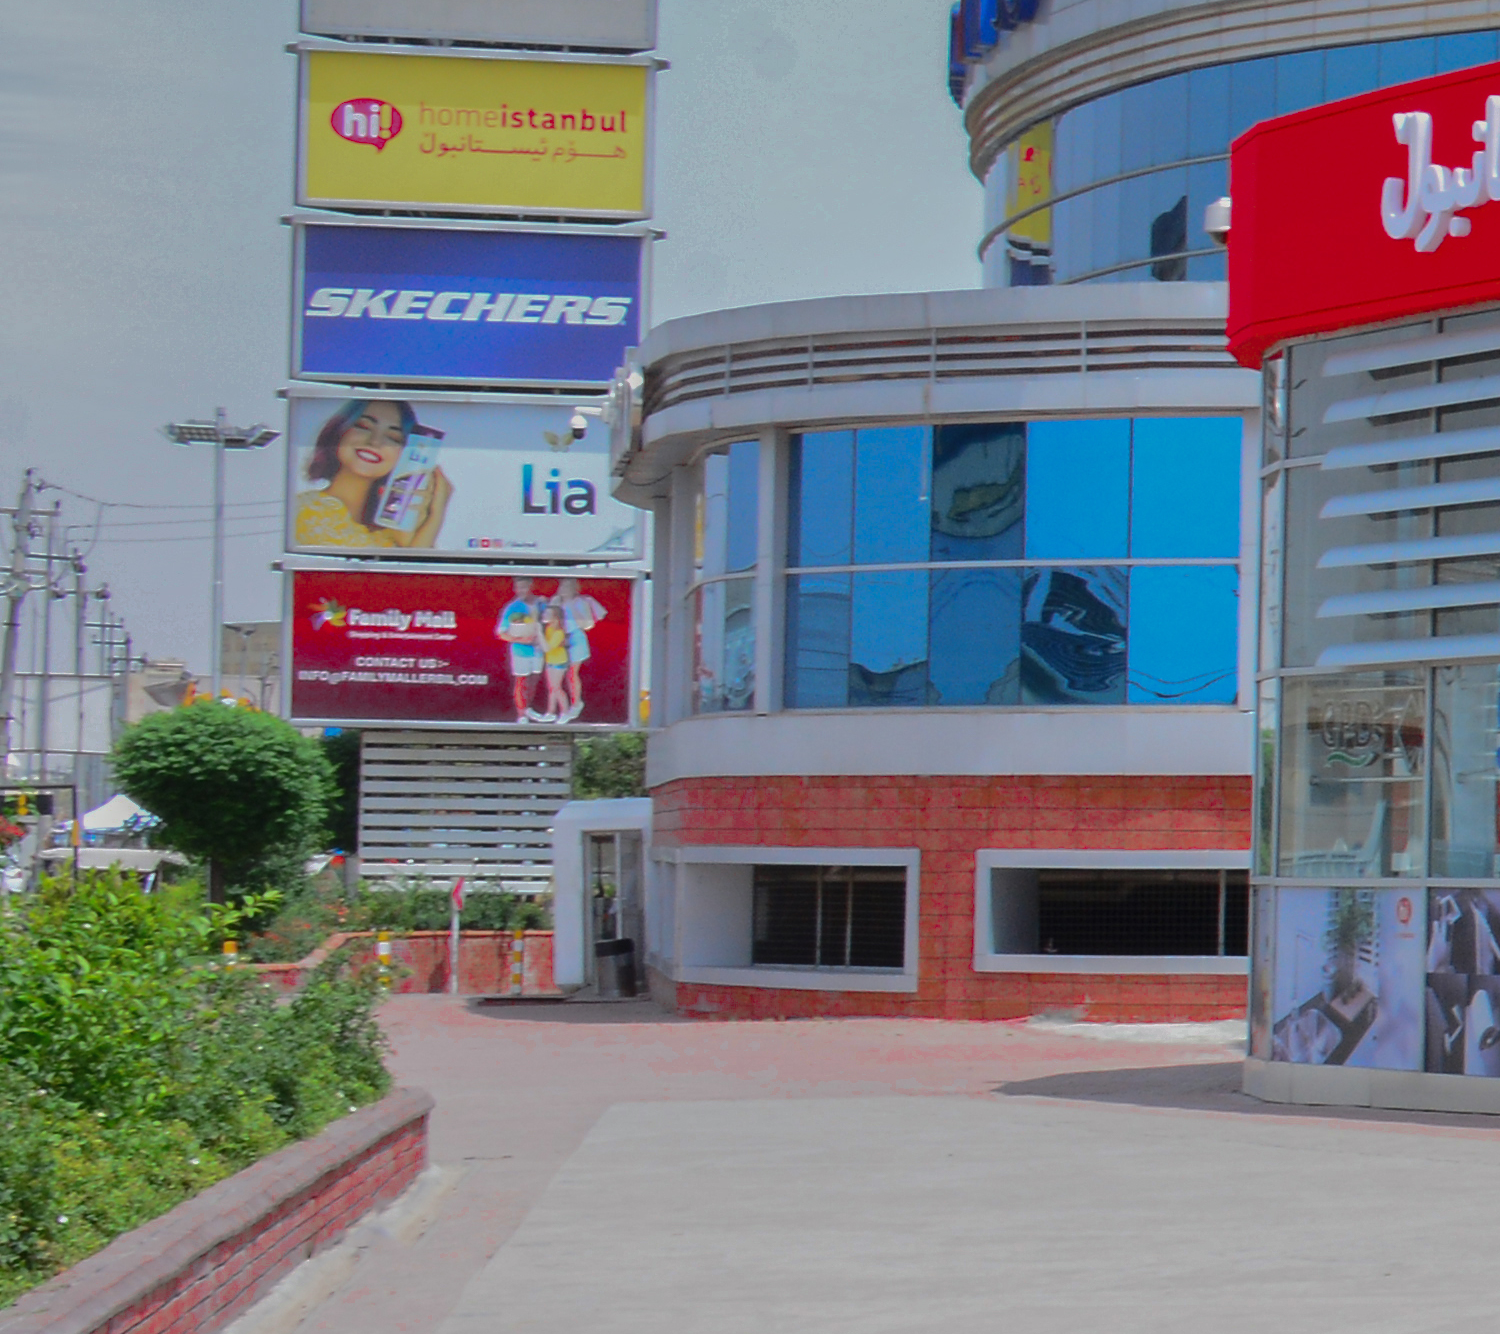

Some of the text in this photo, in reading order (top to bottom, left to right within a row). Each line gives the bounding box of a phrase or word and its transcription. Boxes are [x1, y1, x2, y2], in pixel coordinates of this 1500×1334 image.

[343, 103, 393, 140] hi!
[419, 101, 626, 133] homeistanbul
[305, 287, 632, 326] SKECHERS
[521, 463, 597, 516] Lia
[347, 607, 458, 632] Family Mall
[355, 656, 416, 669] CONTACT
